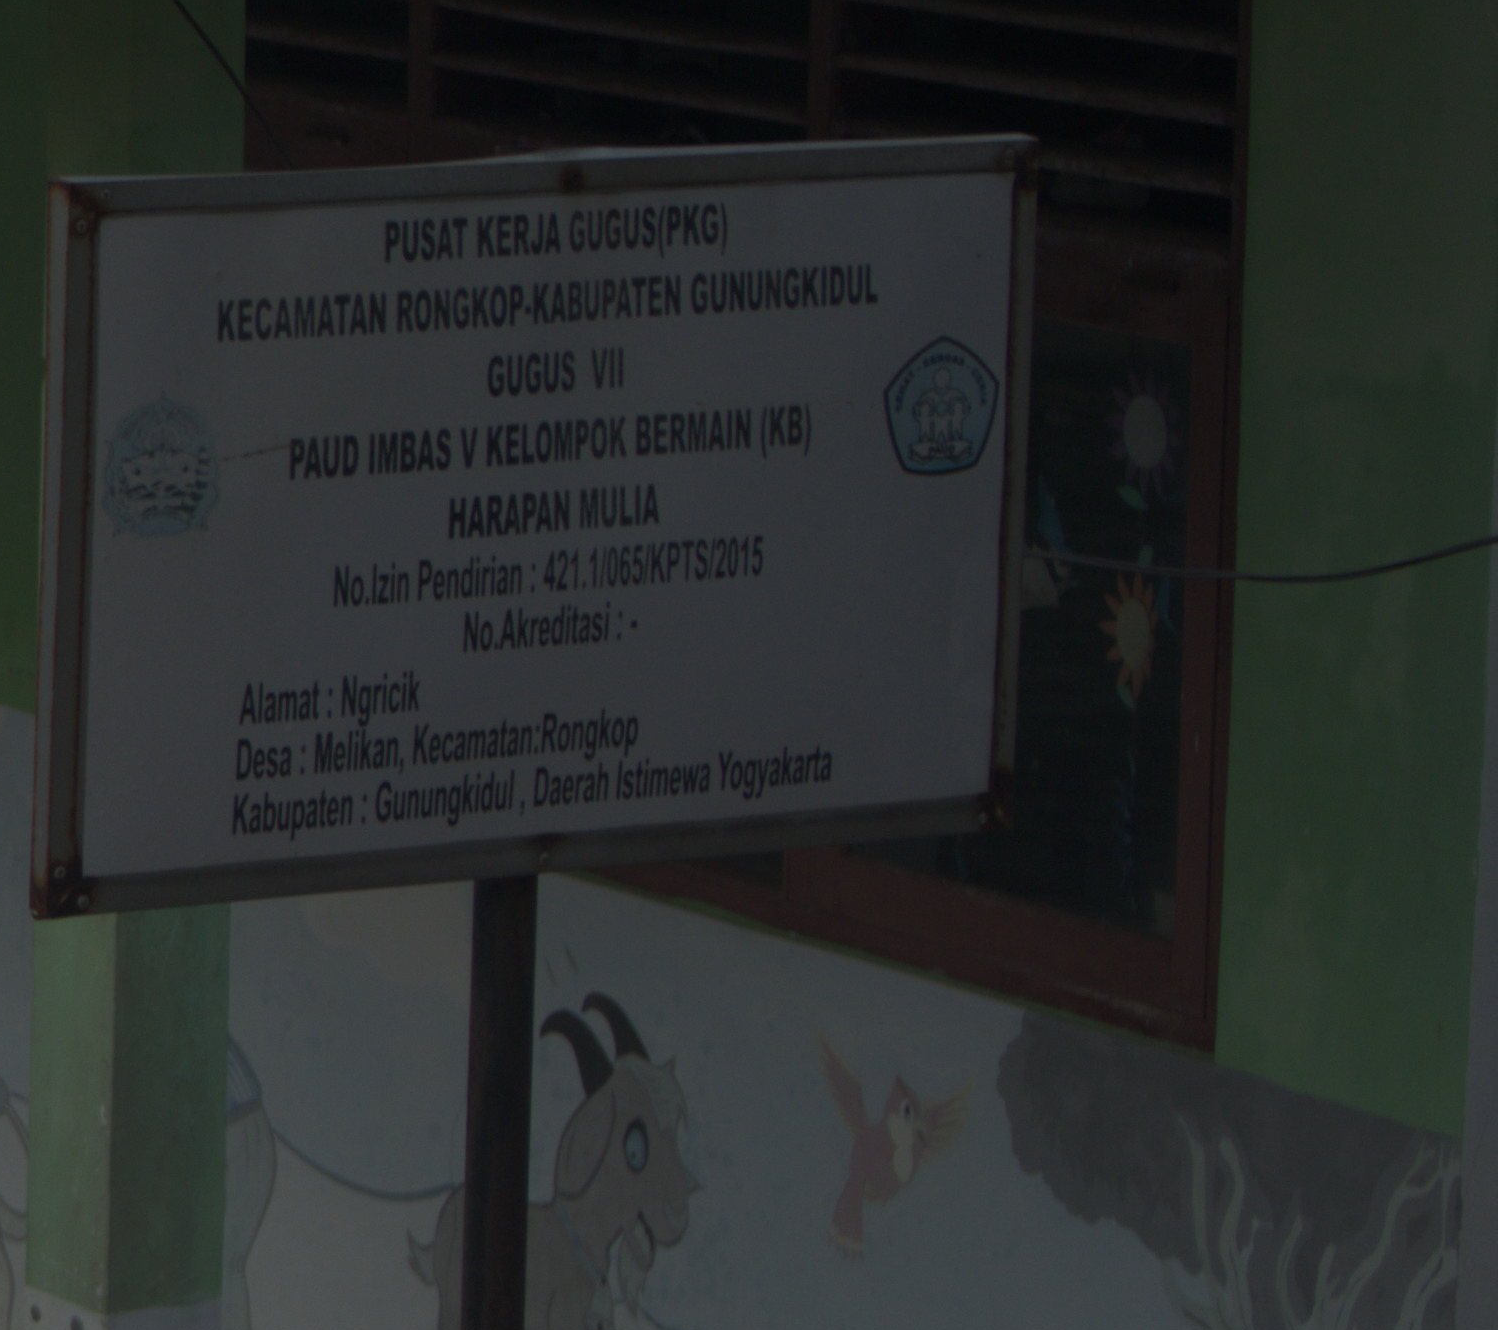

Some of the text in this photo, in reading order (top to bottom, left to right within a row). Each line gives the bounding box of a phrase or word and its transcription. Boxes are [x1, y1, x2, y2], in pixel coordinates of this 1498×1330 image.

[384, 216, 469, 263] PUSAT
[476, 211, 562, 258] KERJA
[217, 291, 388, 343] KECAMATAN
[690, 263, 879, 315] GUNUNGKIDUL
[487, 346, 625, 398] GUGUS VII
[289, 404, 813, 480] PAUD IMBAS V KELOMPOK BERMAIN (KB)
[448, 483, 660, 540] HARAPAN MULIA
[417, 555, 524, 601] Pendirian
[529, 562, 538, 594] :
[542, 534, 765, 592] 421.1/065/KPTS/2015
[615, 609, 625, 642] :
[630, 619, 639, 630] -
[239, 671, 419, 726] Alamat : Ngricik
[235, 737, 293, 782] Desa
[299, 743, 308, 776] :
[313, 728, 405, 774] Melikan,
[231, 789, 354, 841] Kabupaten
[360, 792, 369, 825] :
[374, 769, 516, 827] Gunungkidul
[532, 762, 610, 808] Daerah
[615, 757, 712, 800] Istimewa
[718, 745, 833, 801] Yogyakarta
